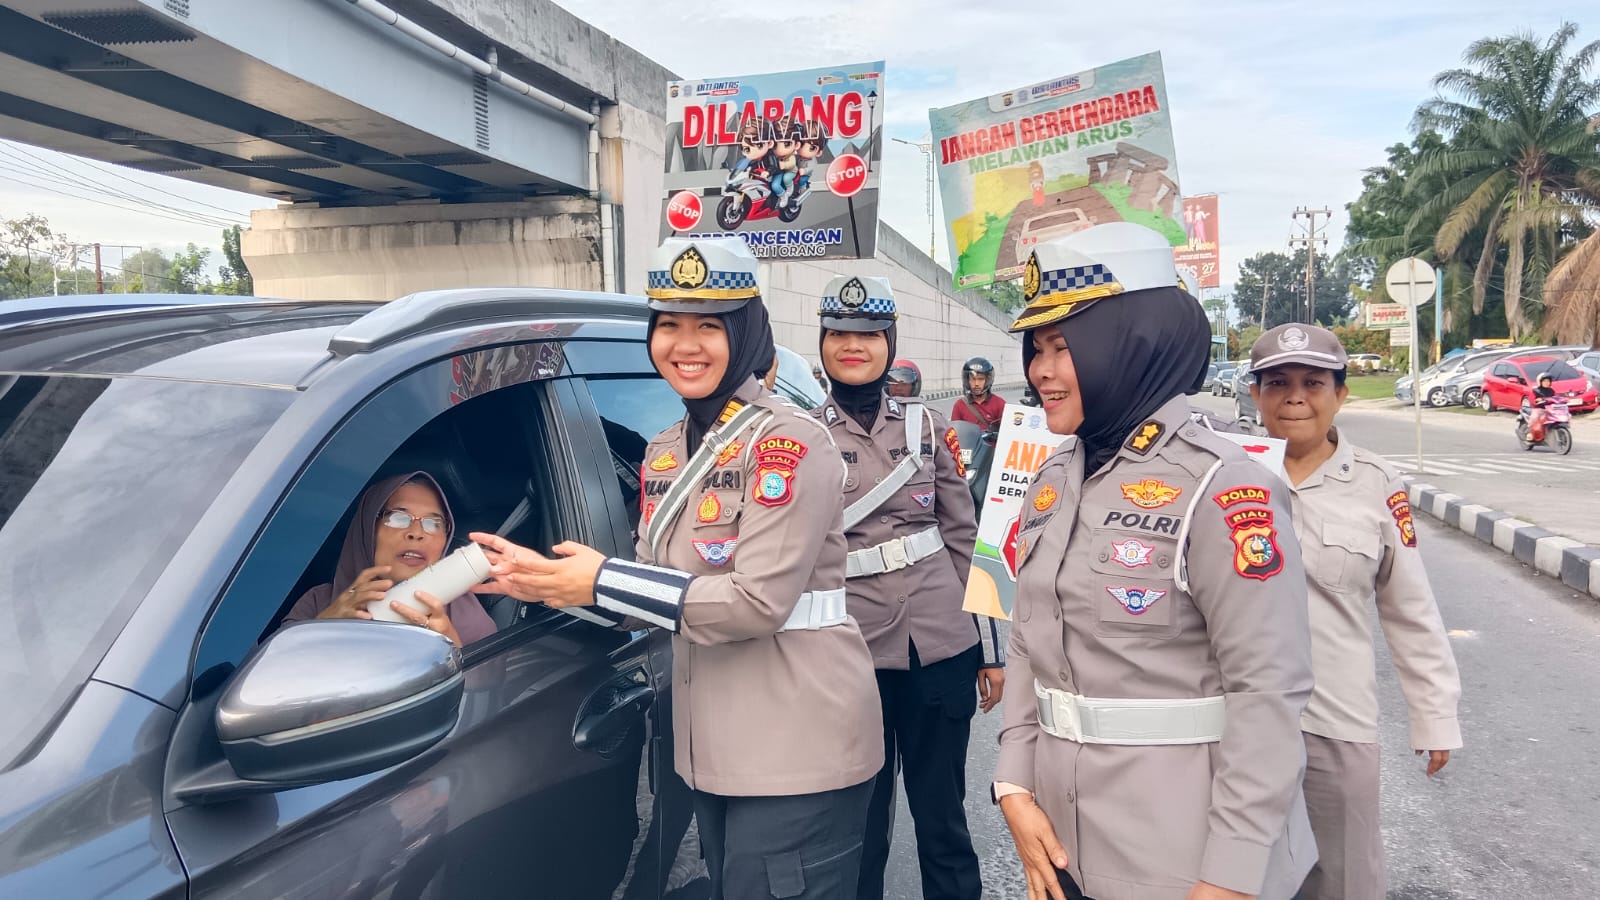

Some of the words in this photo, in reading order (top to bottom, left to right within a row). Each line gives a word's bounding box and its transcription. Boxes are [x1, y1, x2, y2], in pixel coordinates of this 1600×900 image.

[683, 91, 863, 148] DILARANG
[940, 122, 1017, 165] JANGAN
[1018, 85, 1160, 145] BERKENDARA
[968, 136, 1069, 175] MELAWAN
[1077, 120, 1134, 151] ARUS
[828, 165, 864, 184] STOP
[670, 202, 700, 219] STOP
[771, 246, 777, 258] 1
[779, 244, 825, 257] ORANG
[1201, 262, 1215, 275] 27
[759, 438, 801, 454] POLDA
[763, 456, 791, 464] RIAU
[1003, 440, 1057, 474] ANA
[1220, 489, 1265, 505] POLDA
[1103, 510, 1181, 535] POLRI
[1232, 511, 1267, 522] RIAU
